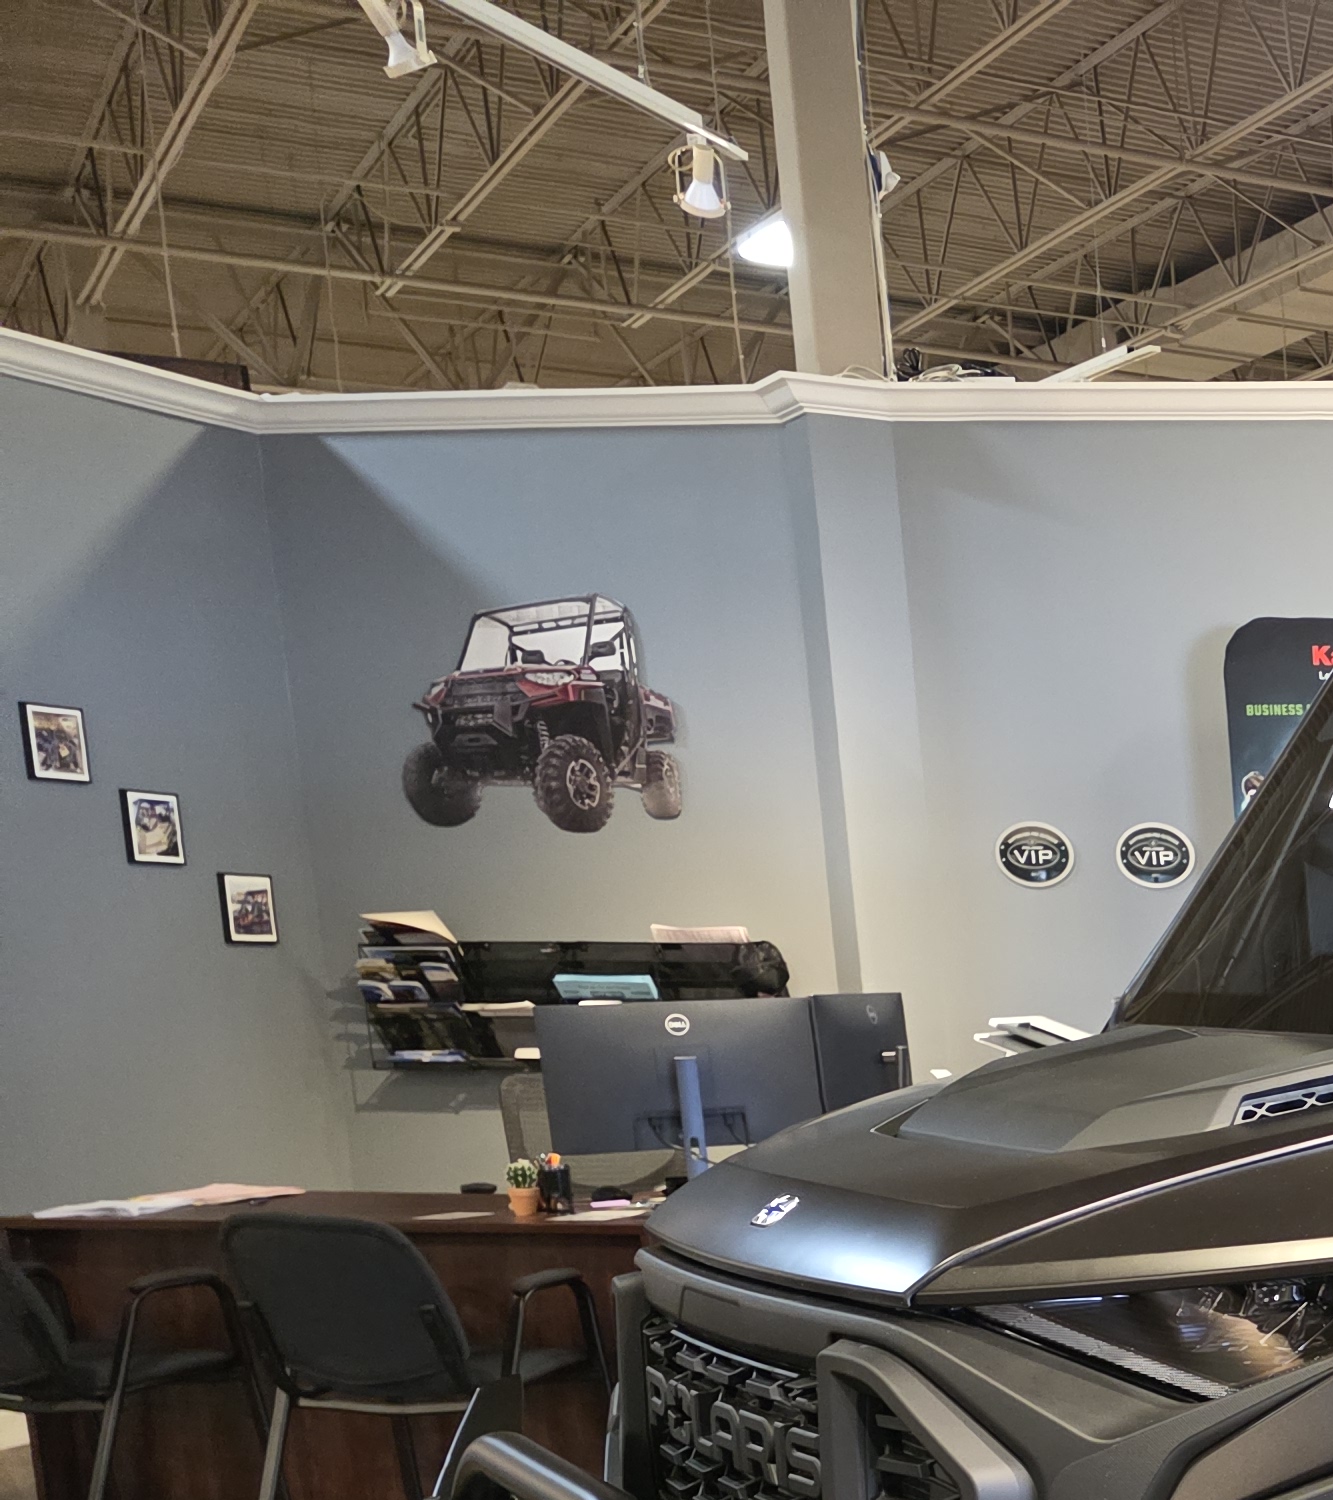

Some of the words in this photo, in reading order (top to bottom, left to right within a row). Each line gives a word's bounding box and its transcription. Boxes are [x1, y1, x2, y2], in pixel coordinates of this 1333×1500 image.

[1246, 703, 1303, 717] BUSINESS
[1013, 849, 1053, 865] VIP
[1134, 850, 1174, 866] VIP
[646, 1364, 822, 1499] POLARIS
